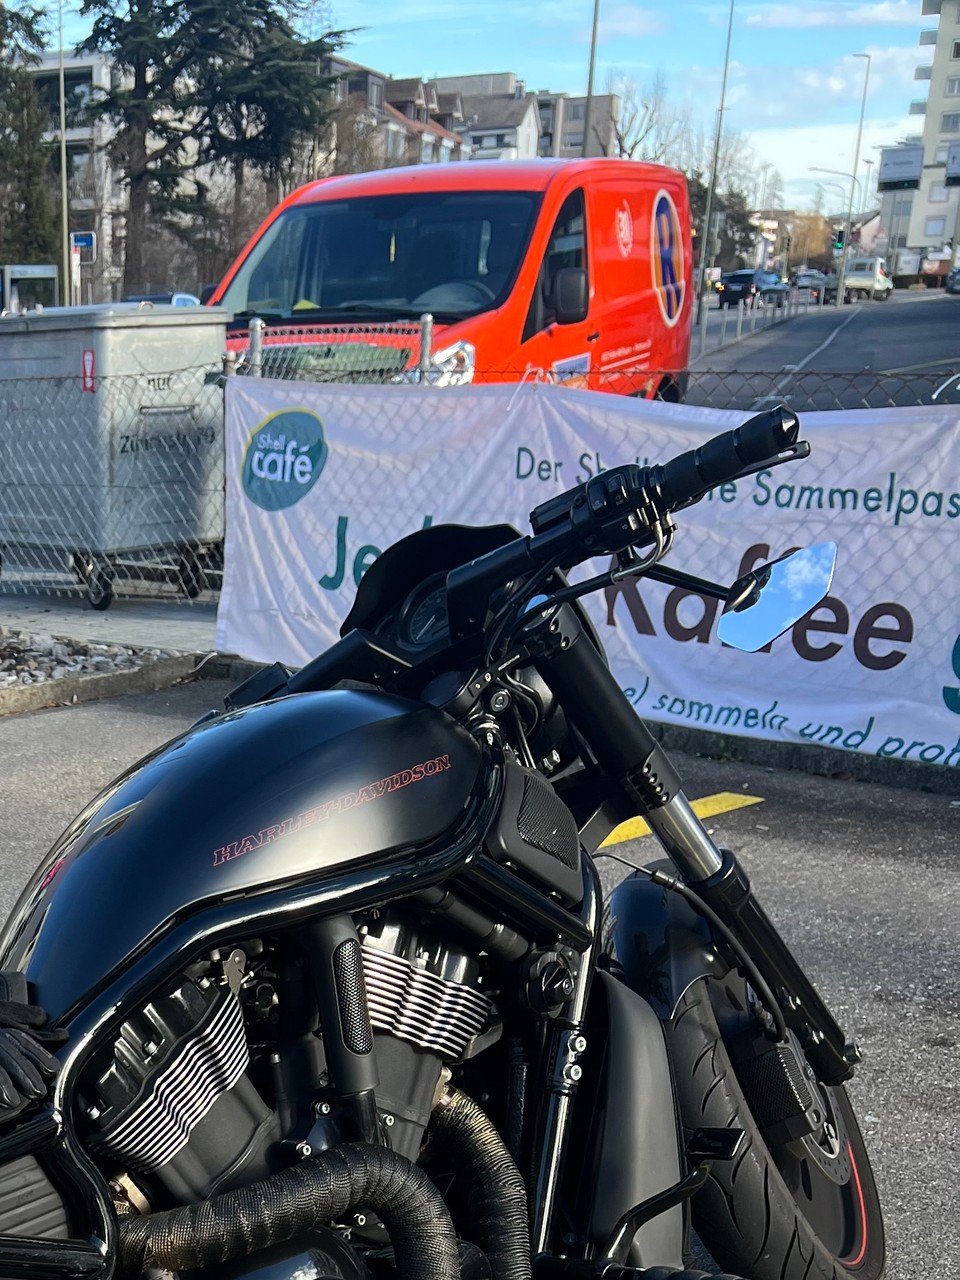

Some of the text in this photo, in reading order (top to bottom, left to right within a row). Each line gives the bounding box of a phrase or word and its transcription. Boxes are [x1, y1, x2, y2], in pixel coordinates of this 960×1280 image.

[257, 433, 286, 451] Shell
[251, 439, 313, 485] café
[515, 446, 563, 483] Der
[798, 716, 876, 750] und
